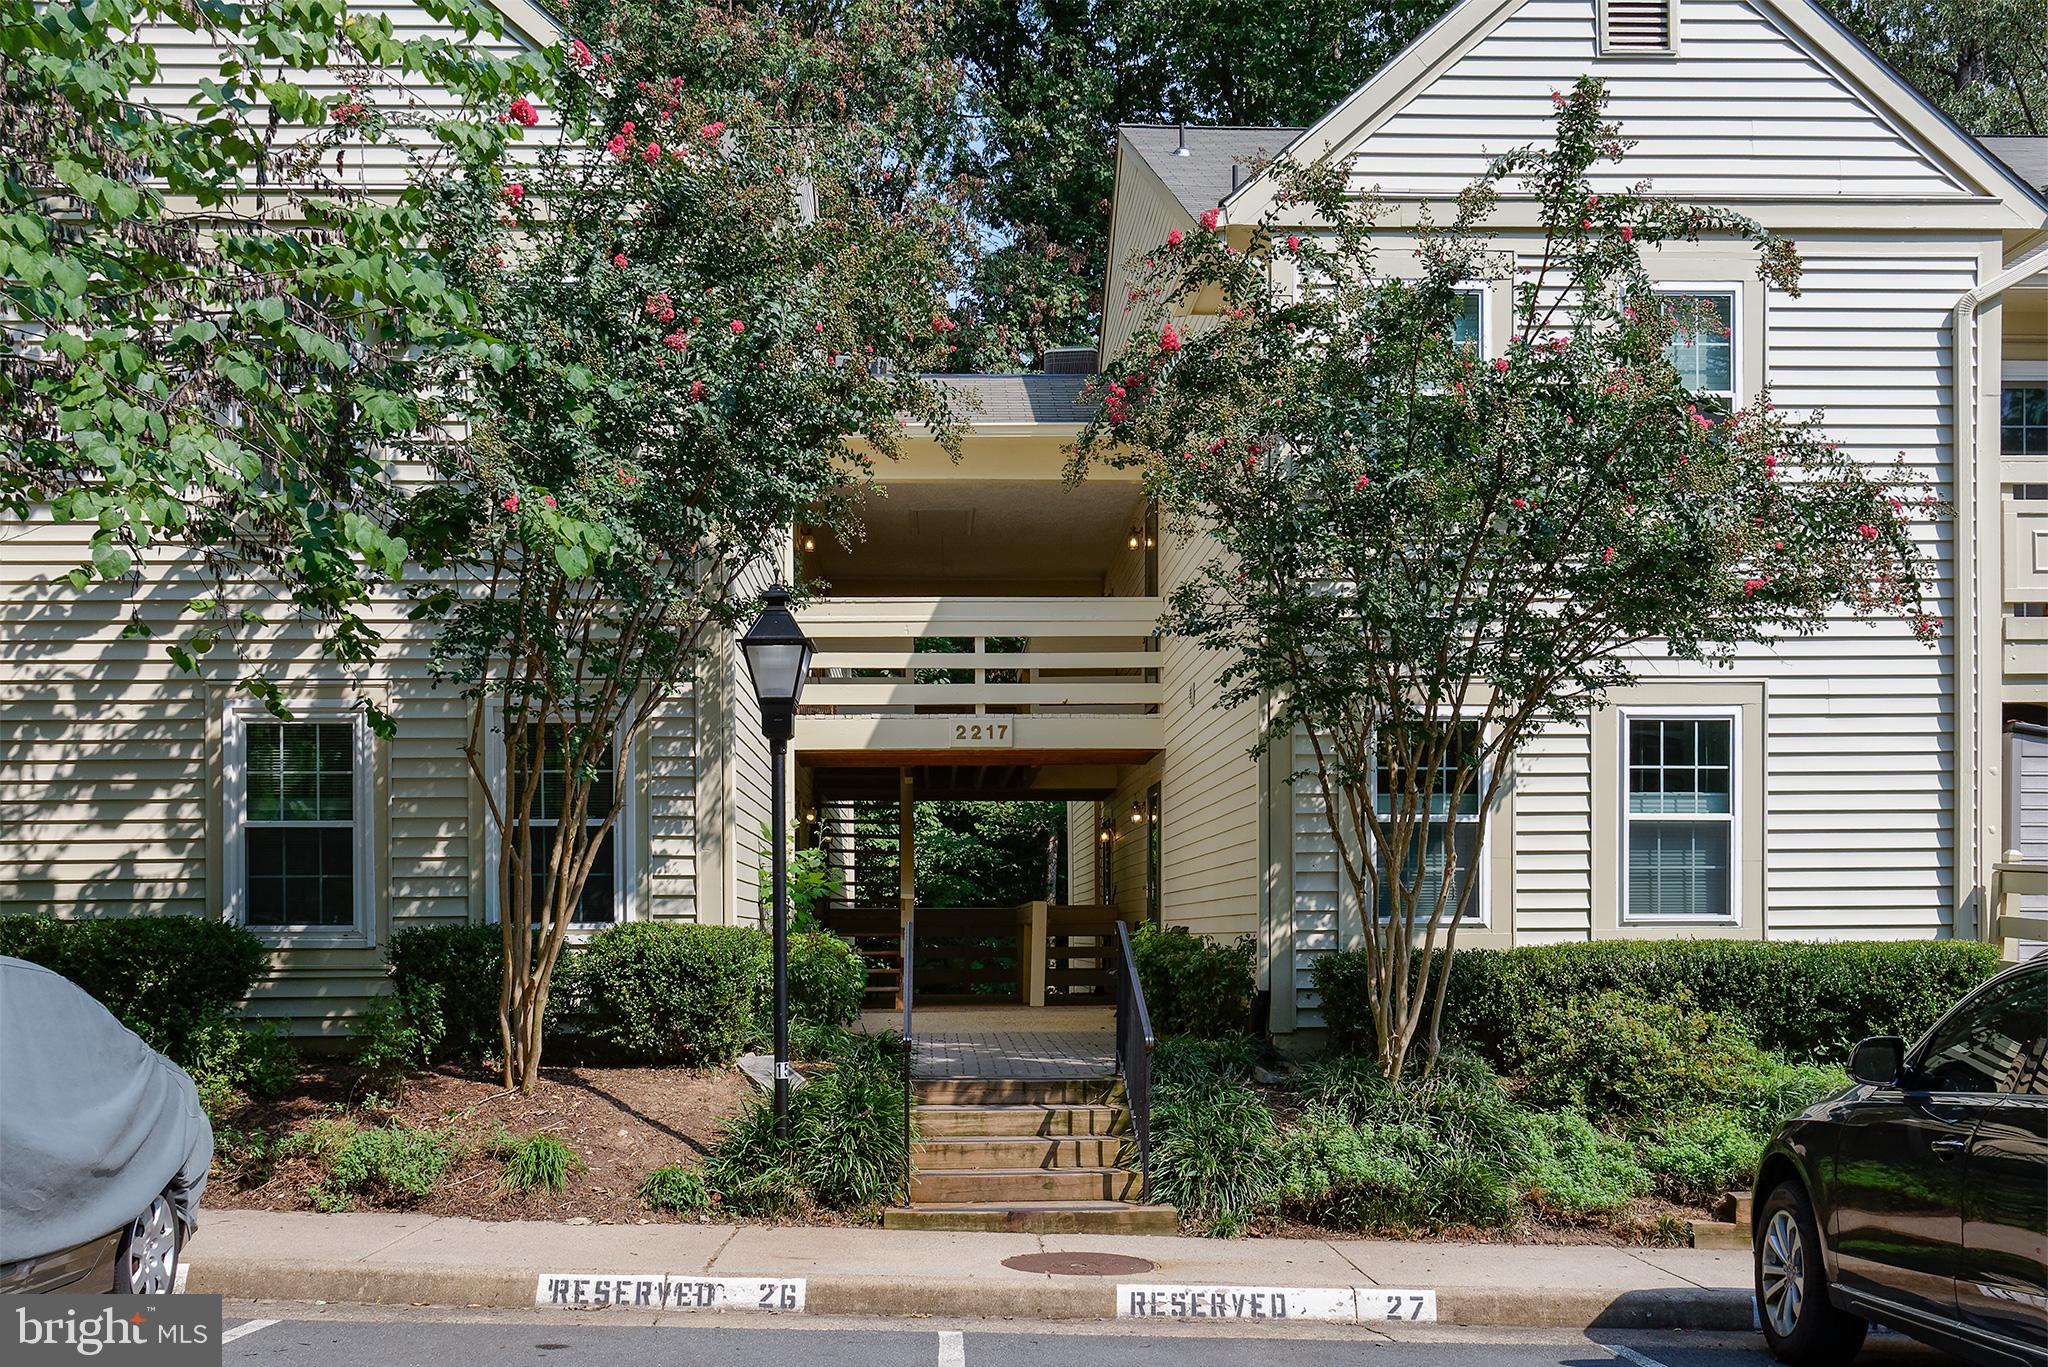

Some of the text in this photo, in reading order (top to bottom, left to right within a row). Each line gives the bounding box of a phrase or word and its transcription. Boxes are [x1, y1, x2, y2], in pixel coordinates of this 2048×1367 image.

[955, 724, 1008, 739] 2217
[549, 1279, 796, 1309] RESERVED 26
[1130, 1291, 1424, 1321] RESERVED 27
